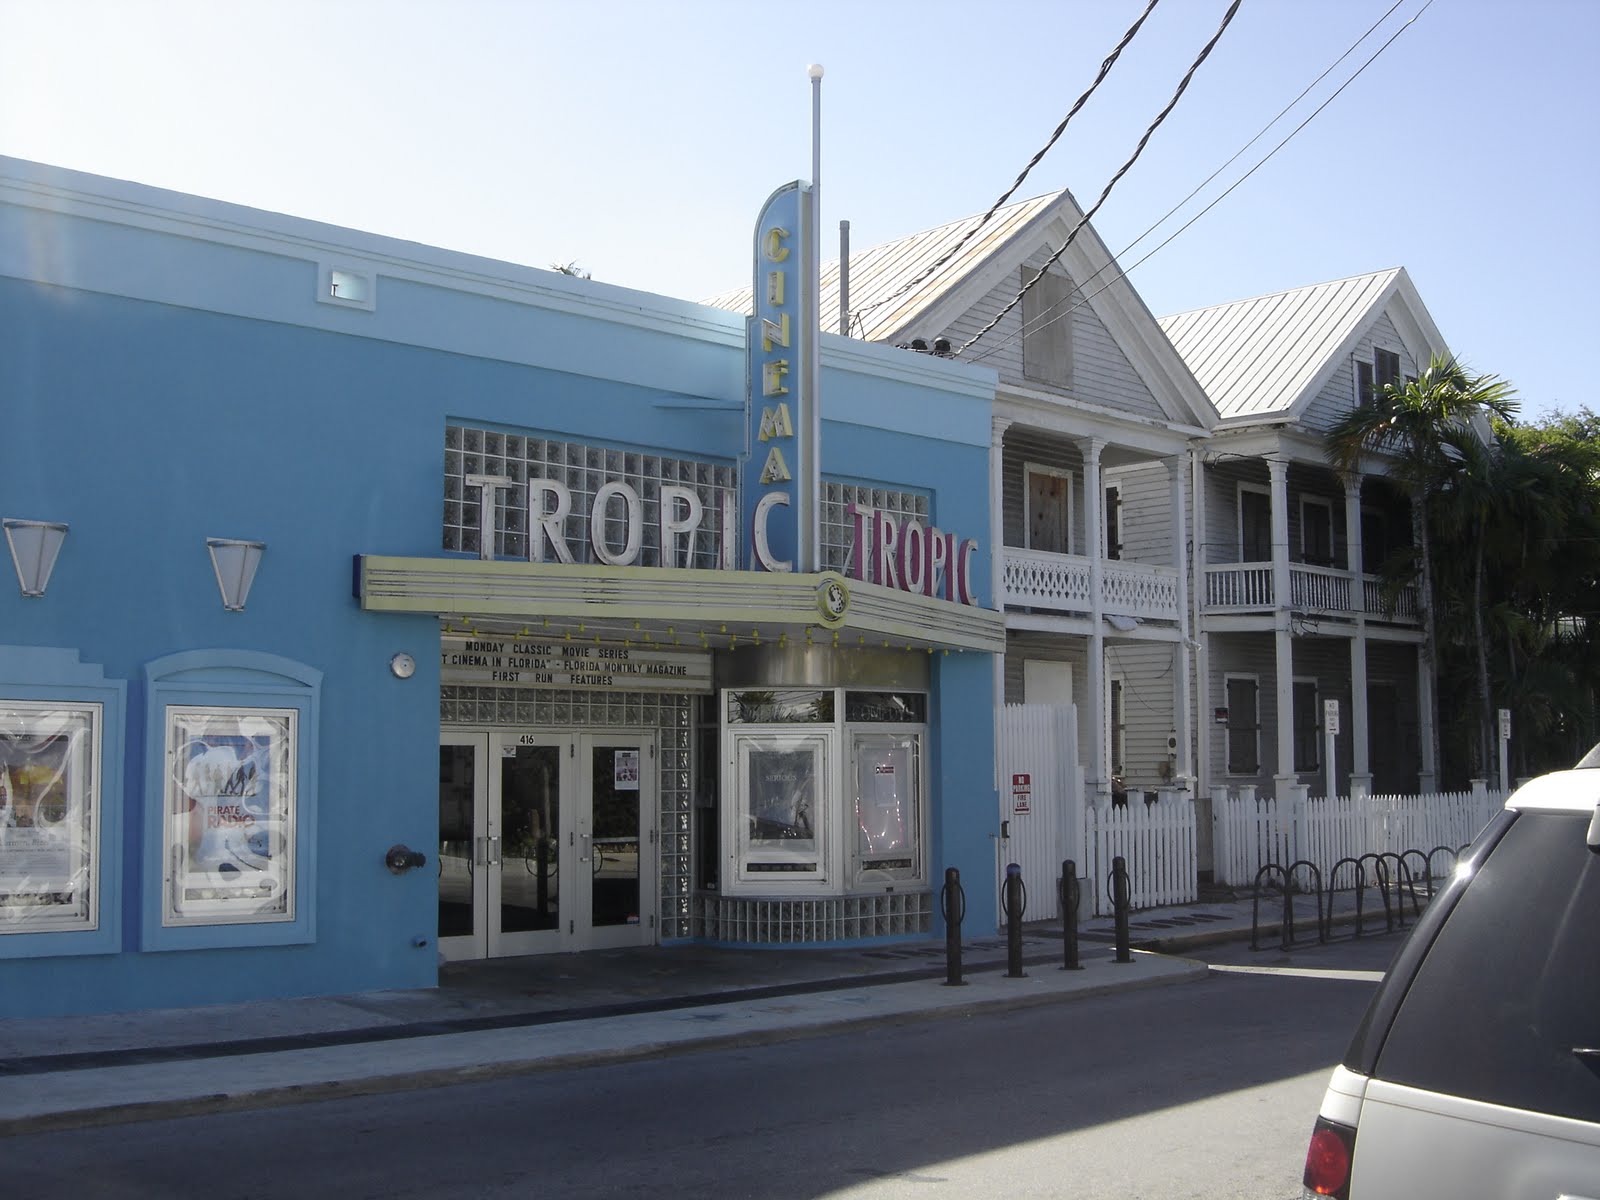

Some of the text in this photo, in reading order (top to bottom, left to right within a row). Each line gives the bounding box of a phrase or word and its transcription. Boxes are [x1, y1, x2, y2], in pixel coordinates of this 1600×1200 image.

[758, 226, 793, 485] CINEMA
[465, 473, 793, 572] TROPIC
[847, 503, 978, 606] TROPIC
[465, 641, 629, 660] MONDAY CLASSIC MOVIE SERIES
[452, 655, 488, 667] CINEMA
[492, 656, 502, 668] IN
[564, 660, 600, 672] FLORIDA
[604, 662, 642, 674] MONTHLY
[646, 664, 687, 676] MAGAZINE
[492, 671, 613, 686] FIRST RUN FEATURES
[519, 734, 534, 745] 416
[208, 806, 241, 815] PIRATE
